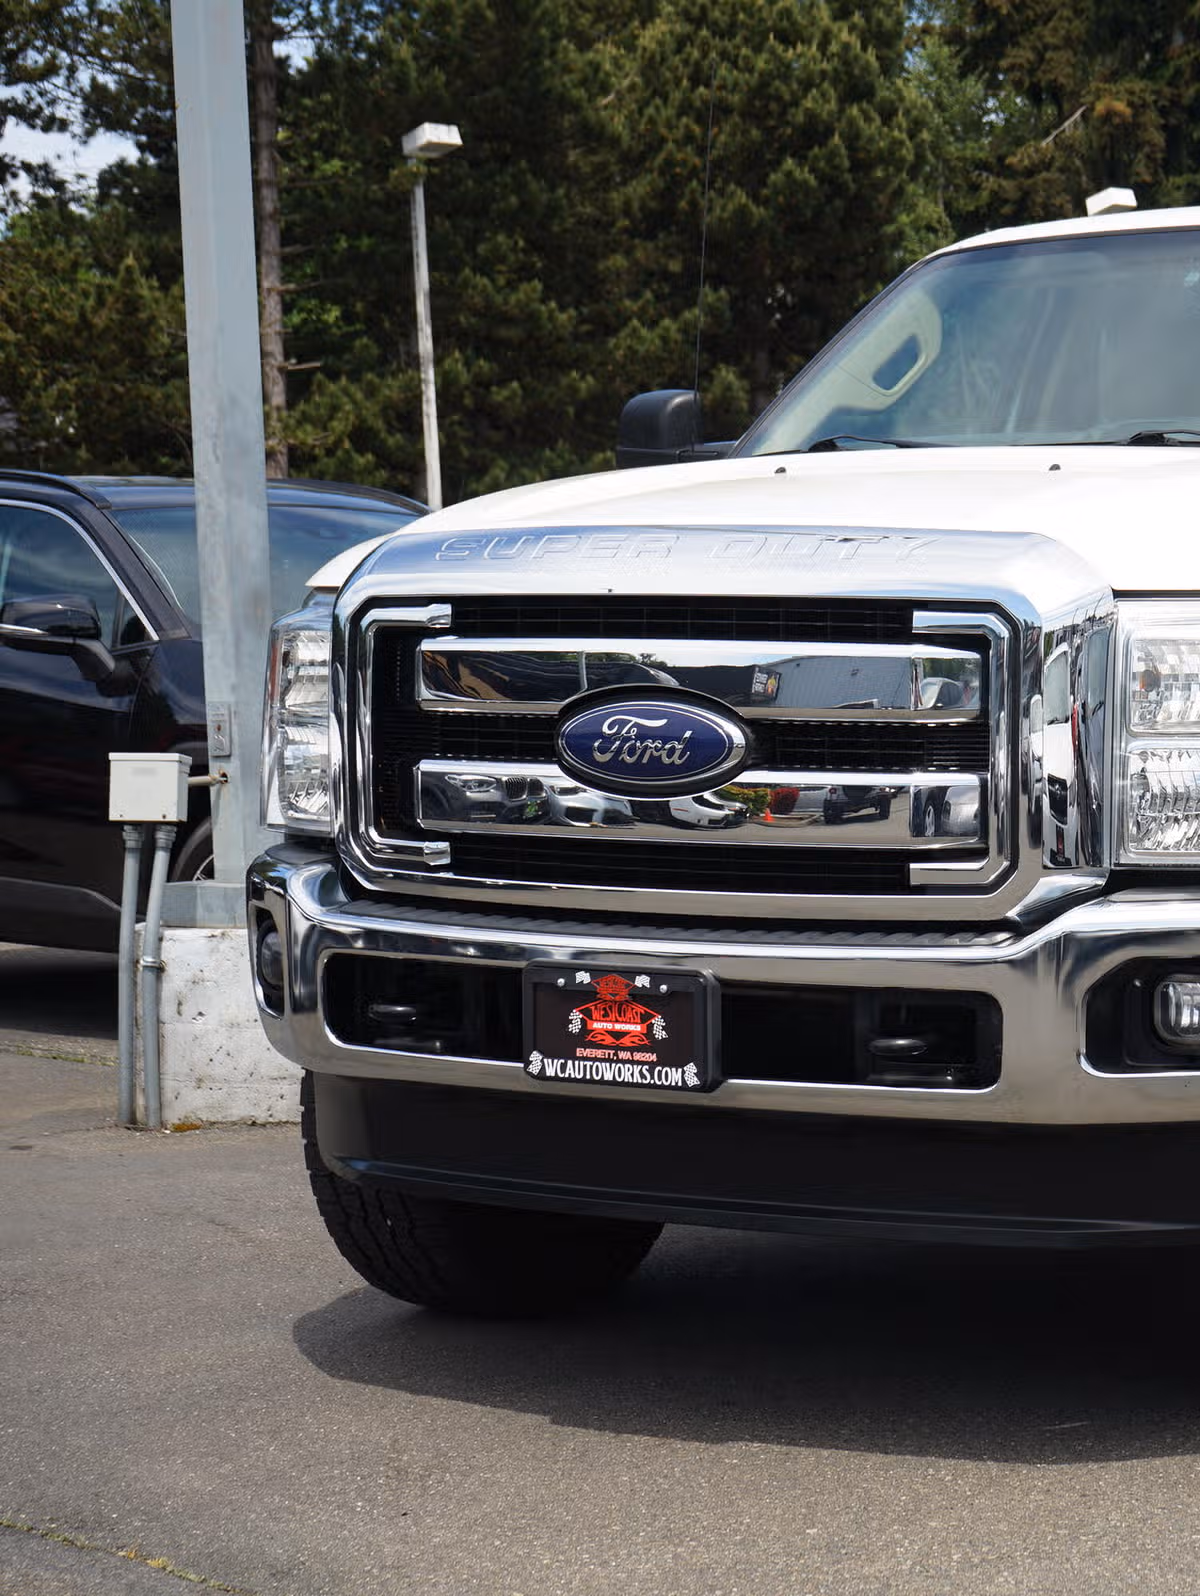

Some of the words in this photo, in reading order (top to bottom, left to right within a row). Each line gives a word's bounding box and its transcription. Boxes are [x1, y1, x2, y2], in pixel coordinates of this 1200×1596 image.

[433, 533, 681, 562] SUPER
[705, 533, 942, 563] DUTY
[592, 714, 693, 766] Ford
[592, 1022, 613, 1030] AUTO
[614, 1024, 642, 1032] WORKS
[576, 1048, 617, 1060] EVERETT,
[618, 1050, 632, 1061] WA
[633, 1052, 657, 1062] 98204
[543, 1058, 683, 1087] WCAUTOWORKS.COM
